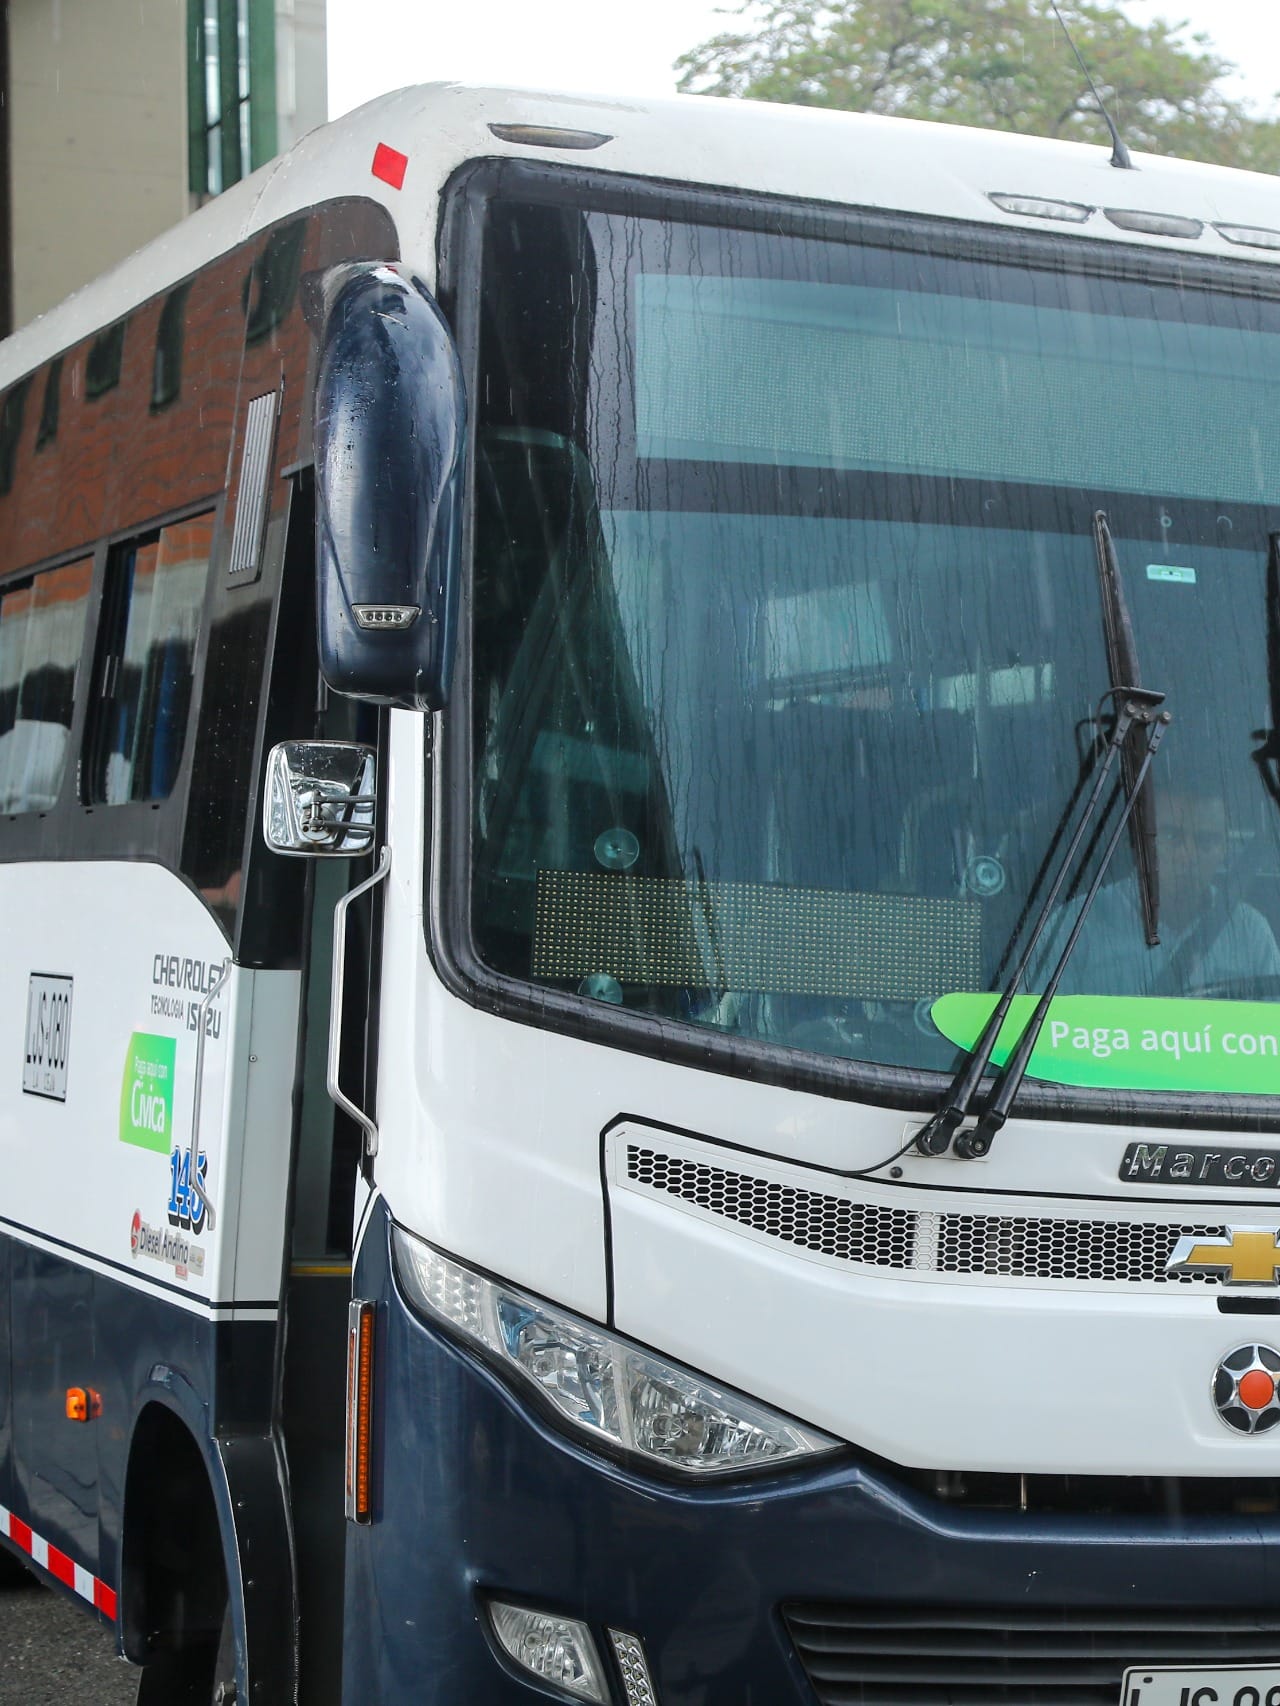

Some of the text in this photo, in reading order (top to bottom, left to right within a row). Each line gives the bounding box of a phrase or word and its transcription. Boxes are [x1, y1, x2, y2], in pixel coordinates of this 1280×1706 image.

[1050, 1020, 1130, 1058] Paga
[1140, 1024, 1212, 1060] aquí
[1221, 1031, 1279, 1056] con
